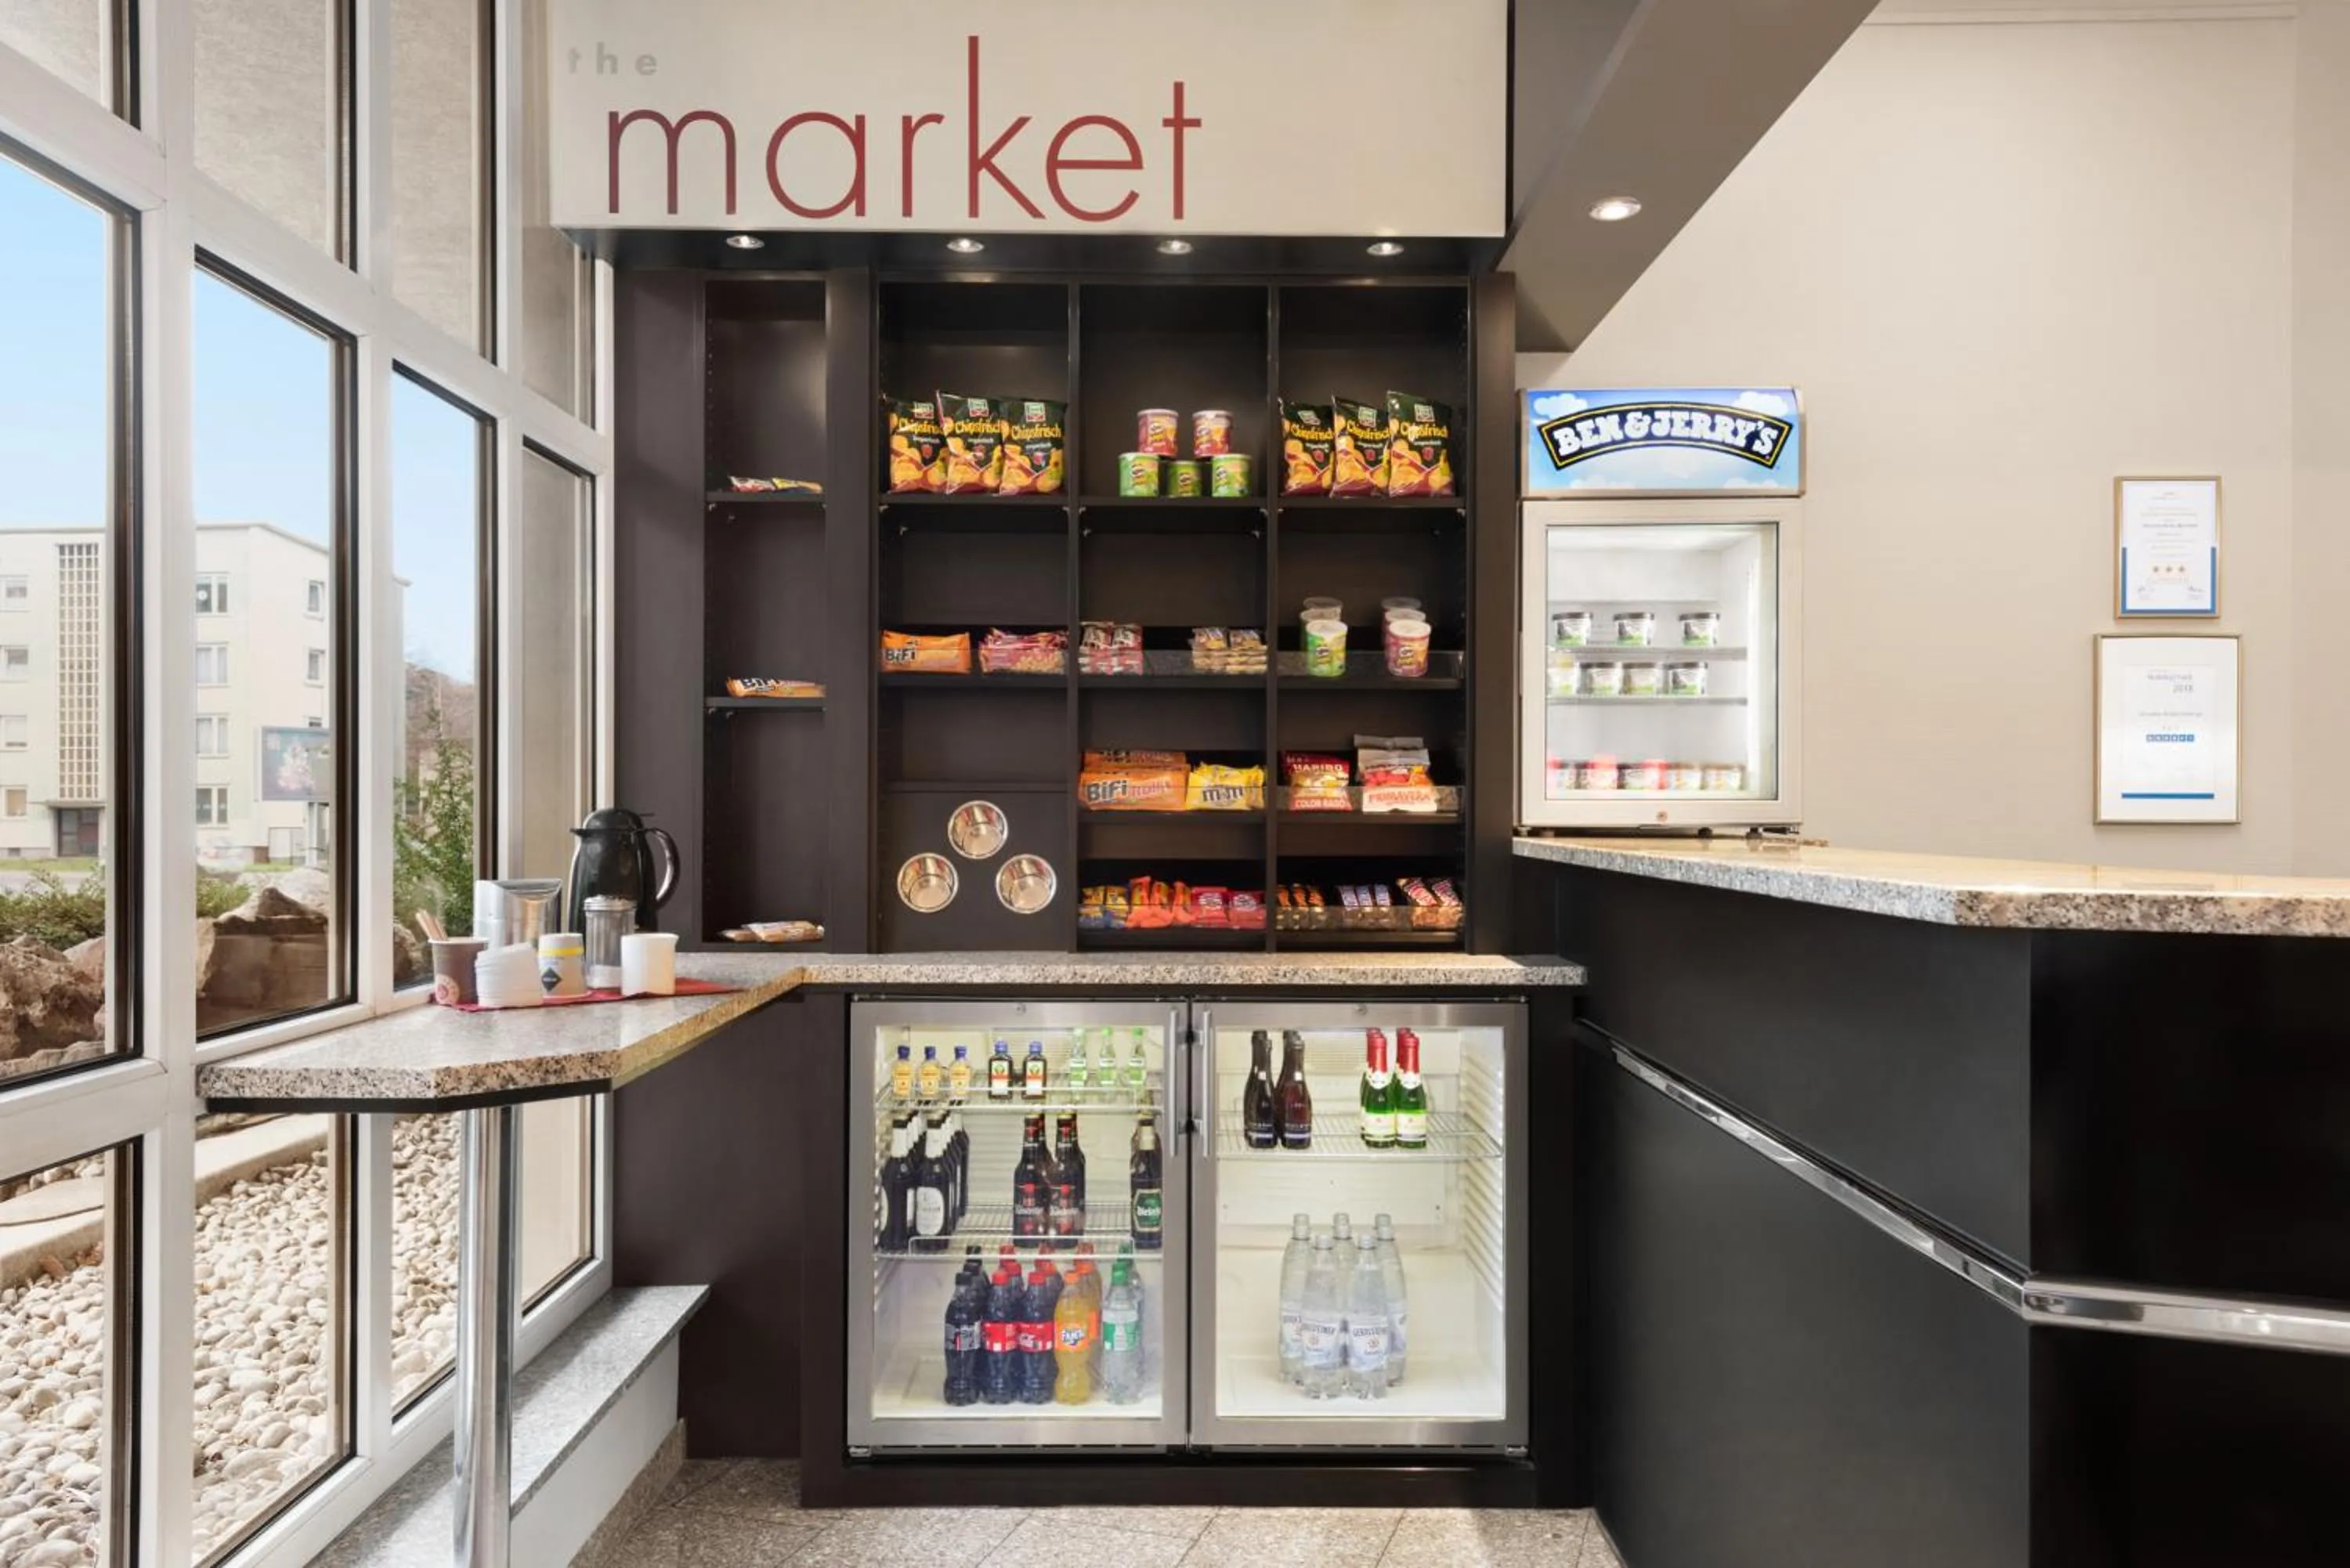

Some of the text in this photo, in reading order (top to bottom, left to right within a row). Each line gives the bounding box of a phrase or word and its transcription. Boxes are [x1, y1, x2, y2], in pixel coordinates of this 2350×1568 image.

[567, 42, 658, 76] the
[608, 35, 1202, 222] market
[1087, 780, 1127, 801] BiFi
